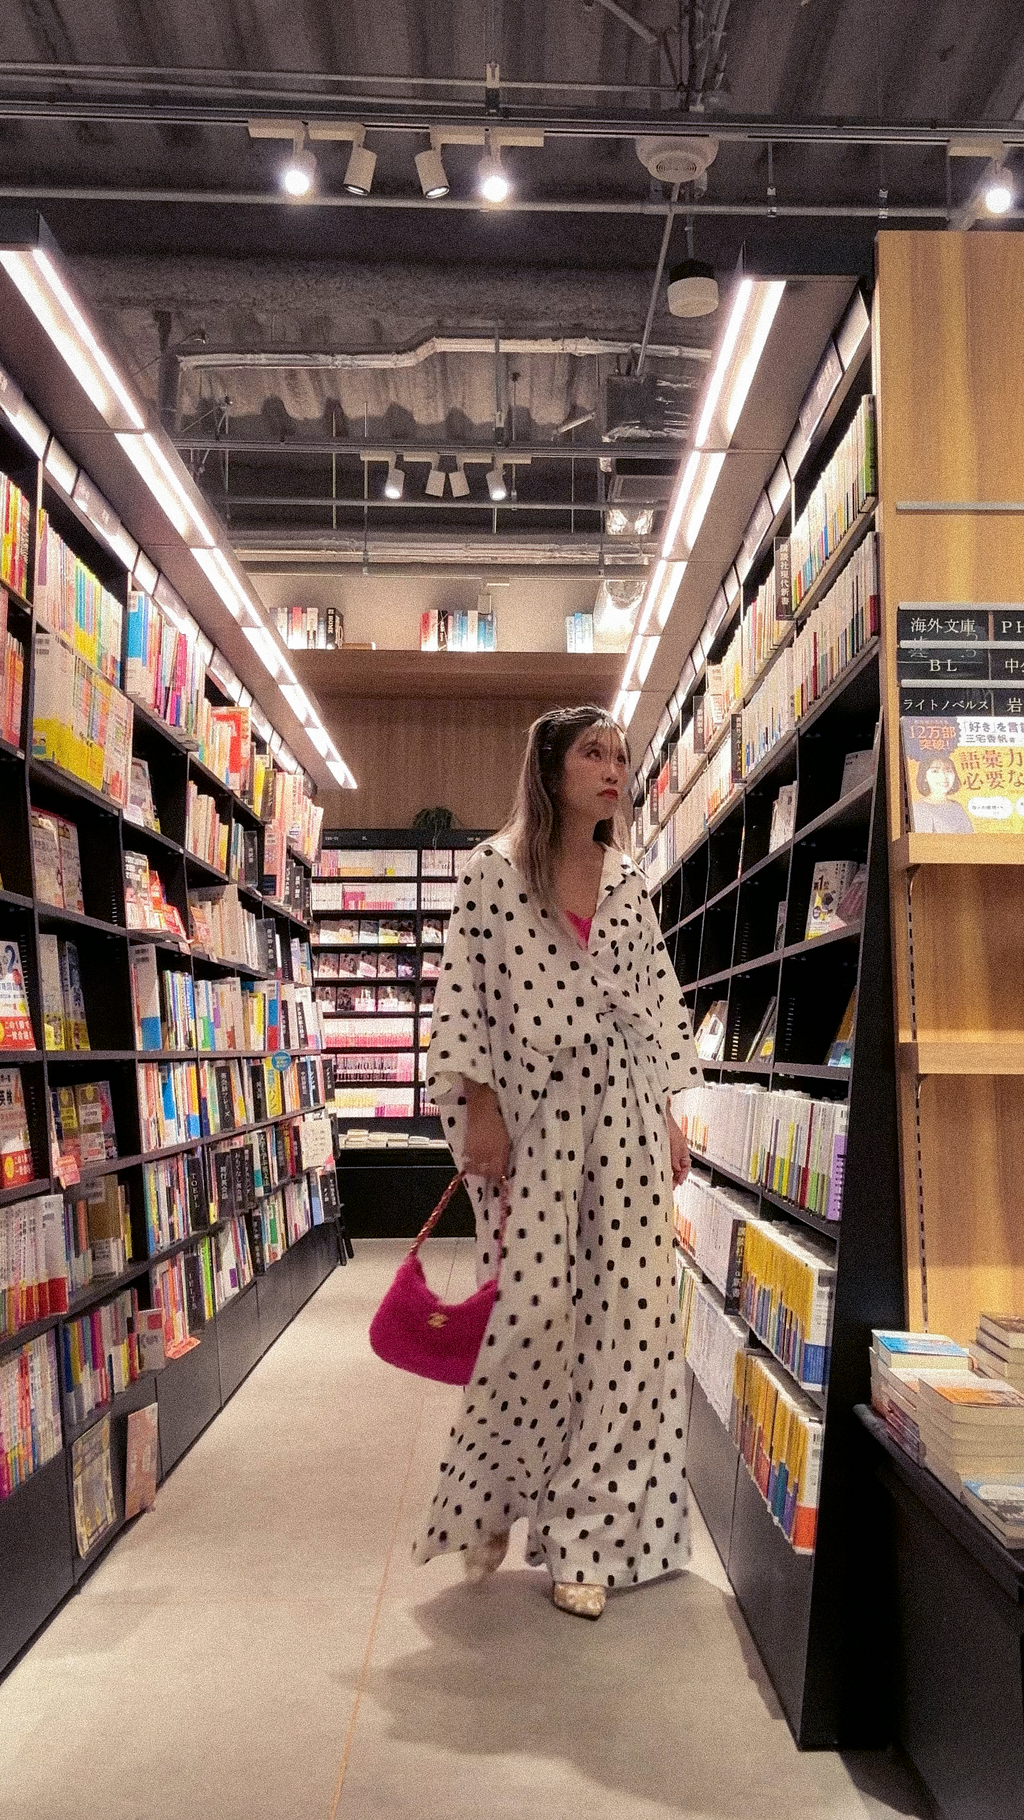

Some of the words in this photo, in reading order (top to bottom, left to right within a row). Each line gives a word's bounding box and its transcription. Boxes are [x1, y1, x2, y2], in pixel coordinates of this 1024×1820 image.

[779, 543, 790, 606] 講談社現代新書
[911, 617, 976, 634] 海外文庫
[929, 659, 958, 672] BL
[903, 699, 989, 710] ライトノベルス
[1007, 697, 1023, 713] 岩
[910, 726, 956, 739] 12万部
[963, 721, 1024, 733] 「好き」を言
[963, 770, 1024, 790] 必要な
[191, 1173, 200, 1208] TOEFL
